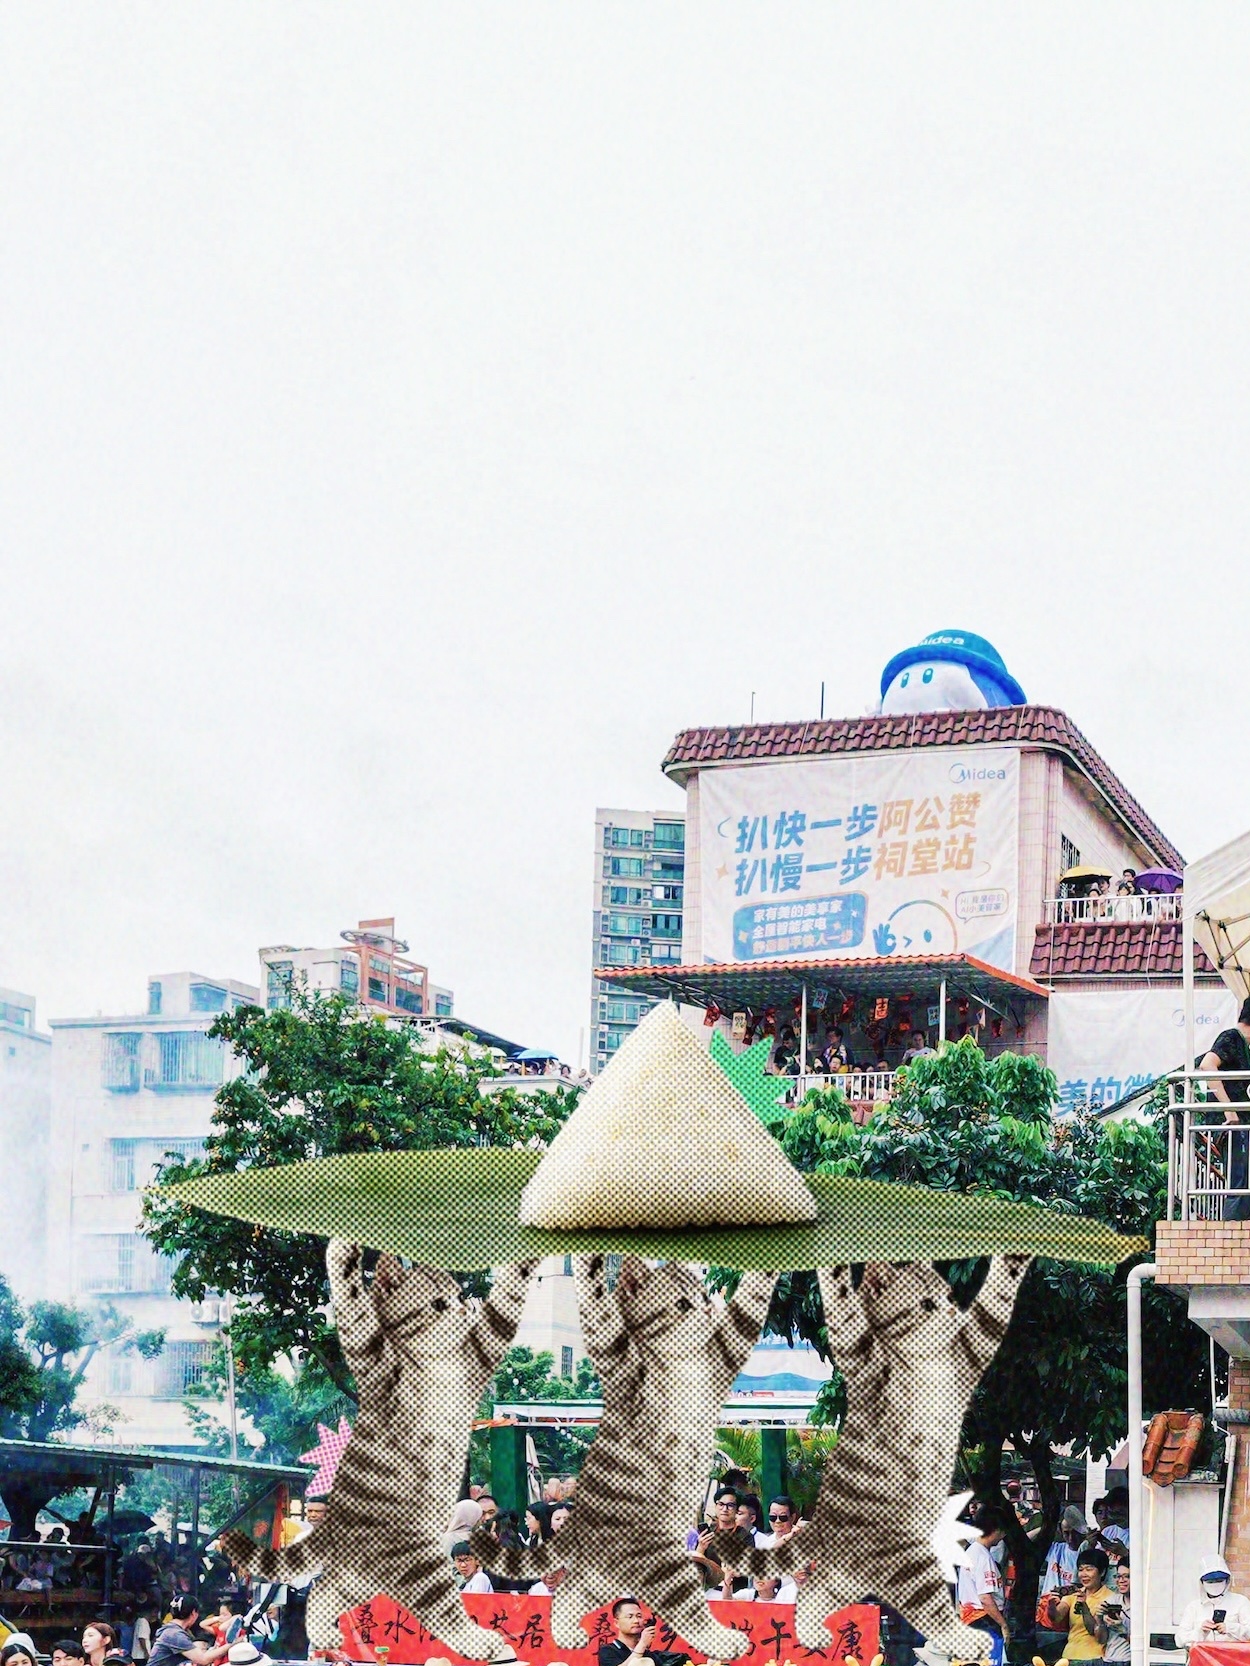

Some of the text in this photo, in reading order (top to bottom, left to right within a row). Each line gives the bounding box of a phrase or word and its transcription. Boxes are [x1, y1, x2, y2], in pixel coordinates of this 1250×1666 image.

[950, 763, 1006, 783] Midea
[735, 791, 982, 854] 扒快一步阿公赞
[735, 833, 978, 897] 扒慢一步祠堂站
